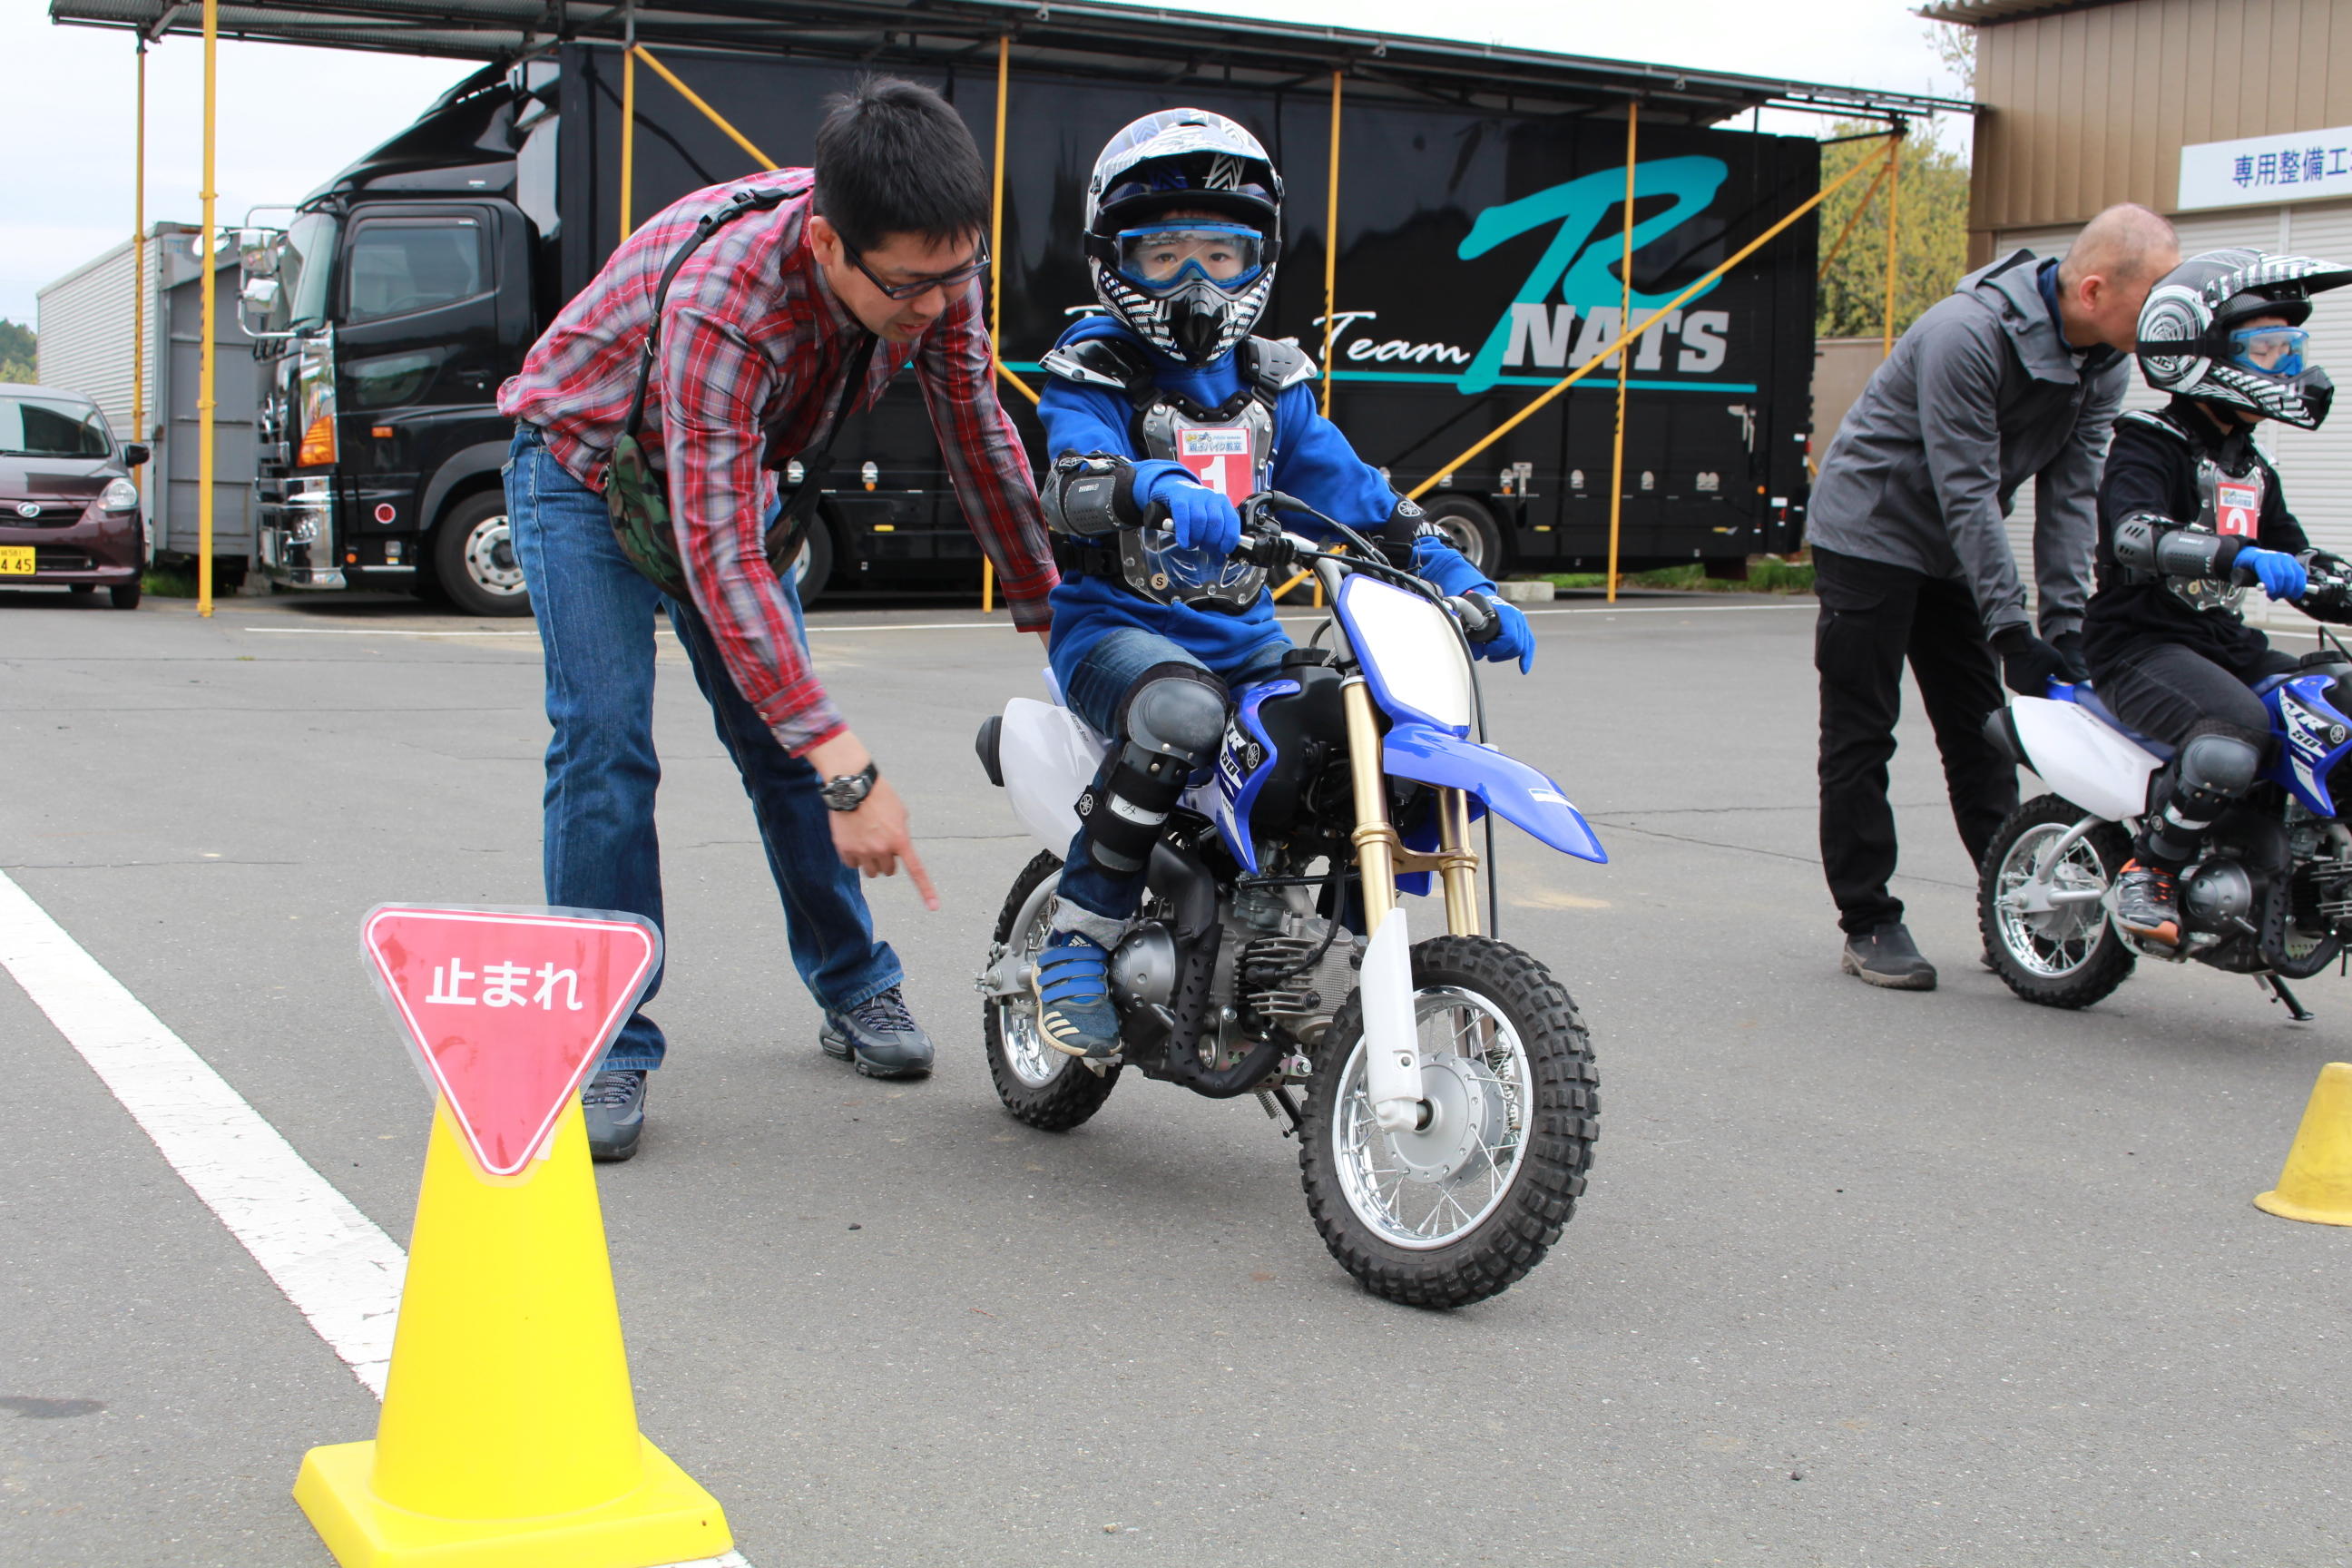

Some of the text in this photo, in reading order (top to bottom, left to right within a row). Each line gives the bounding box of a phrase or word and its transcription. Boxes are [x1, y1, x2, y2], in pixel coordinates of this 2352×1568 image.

[2232, 145, 2352, 188] 専用整備工
[1312, 311, 1471, 364] Team
[1503, 302, 1730, 373] NATS
[1200, 456, 1227, 495] 1
[426, 957, 583, 1011] 止まれ
